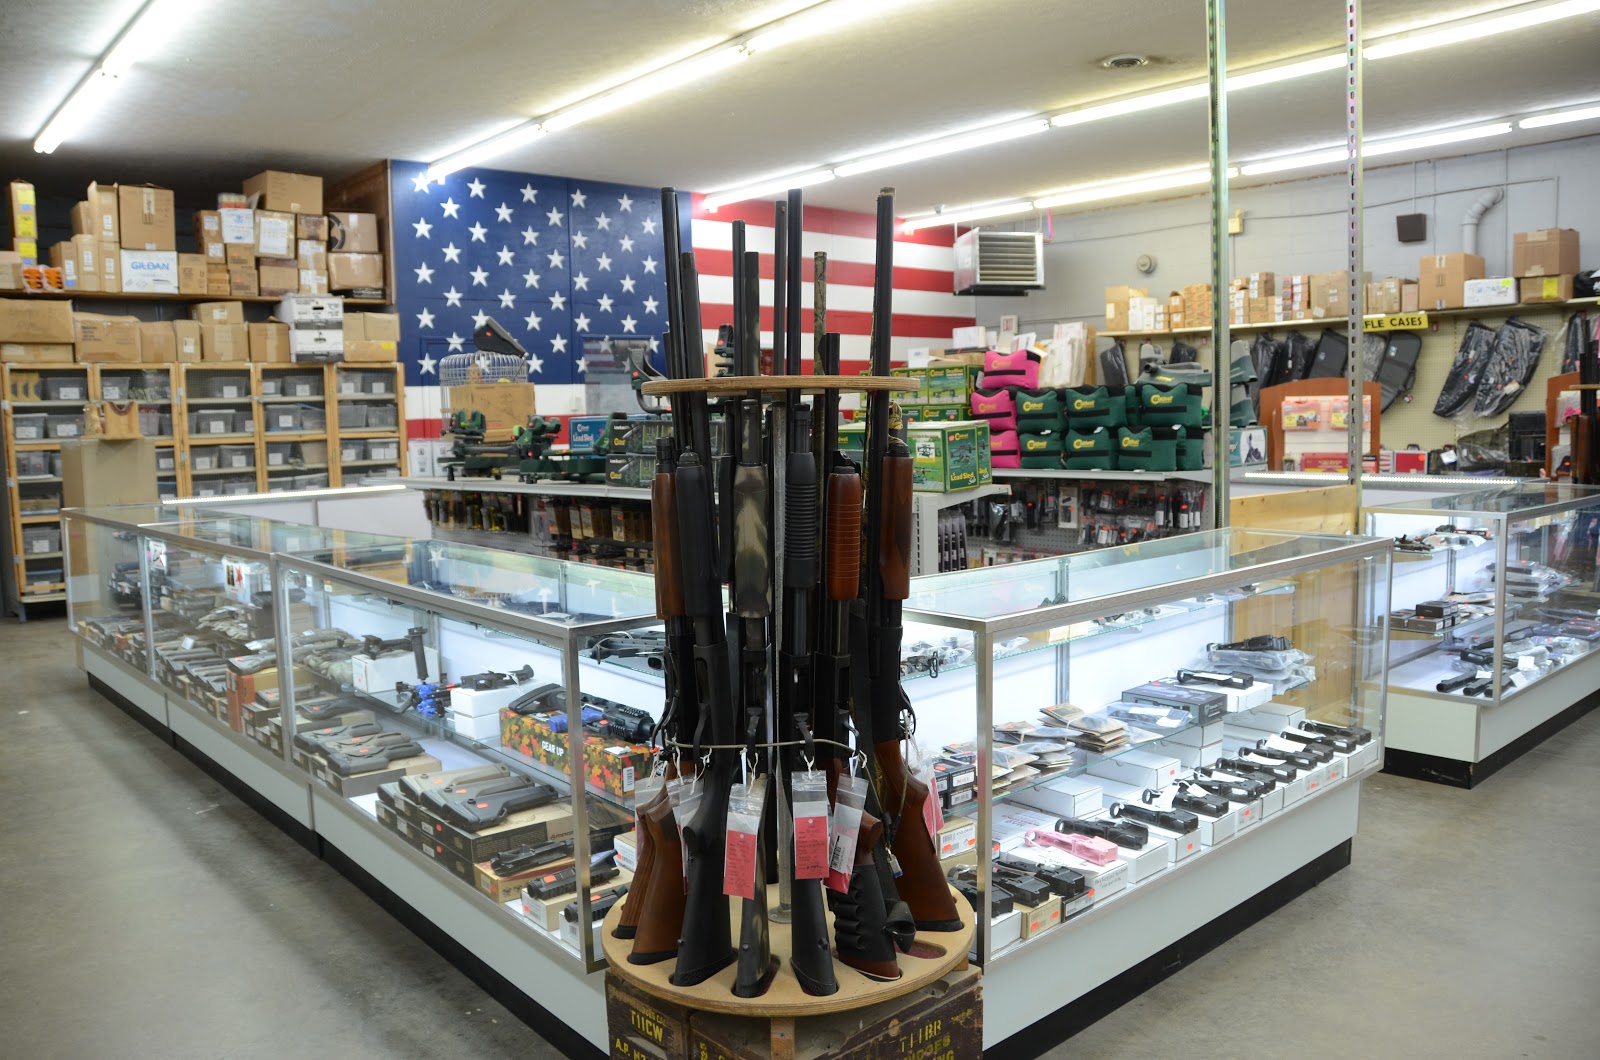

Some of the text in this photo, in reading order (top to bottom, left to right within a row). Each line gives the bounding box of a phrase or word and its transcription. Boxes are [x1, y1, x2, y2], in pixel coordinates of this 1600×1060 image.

[131, 261, 169, 270] GILDAN
[1364, 317, 1422, 328] FLE CASES
[541, 740, 564, 757] GEAR UP
